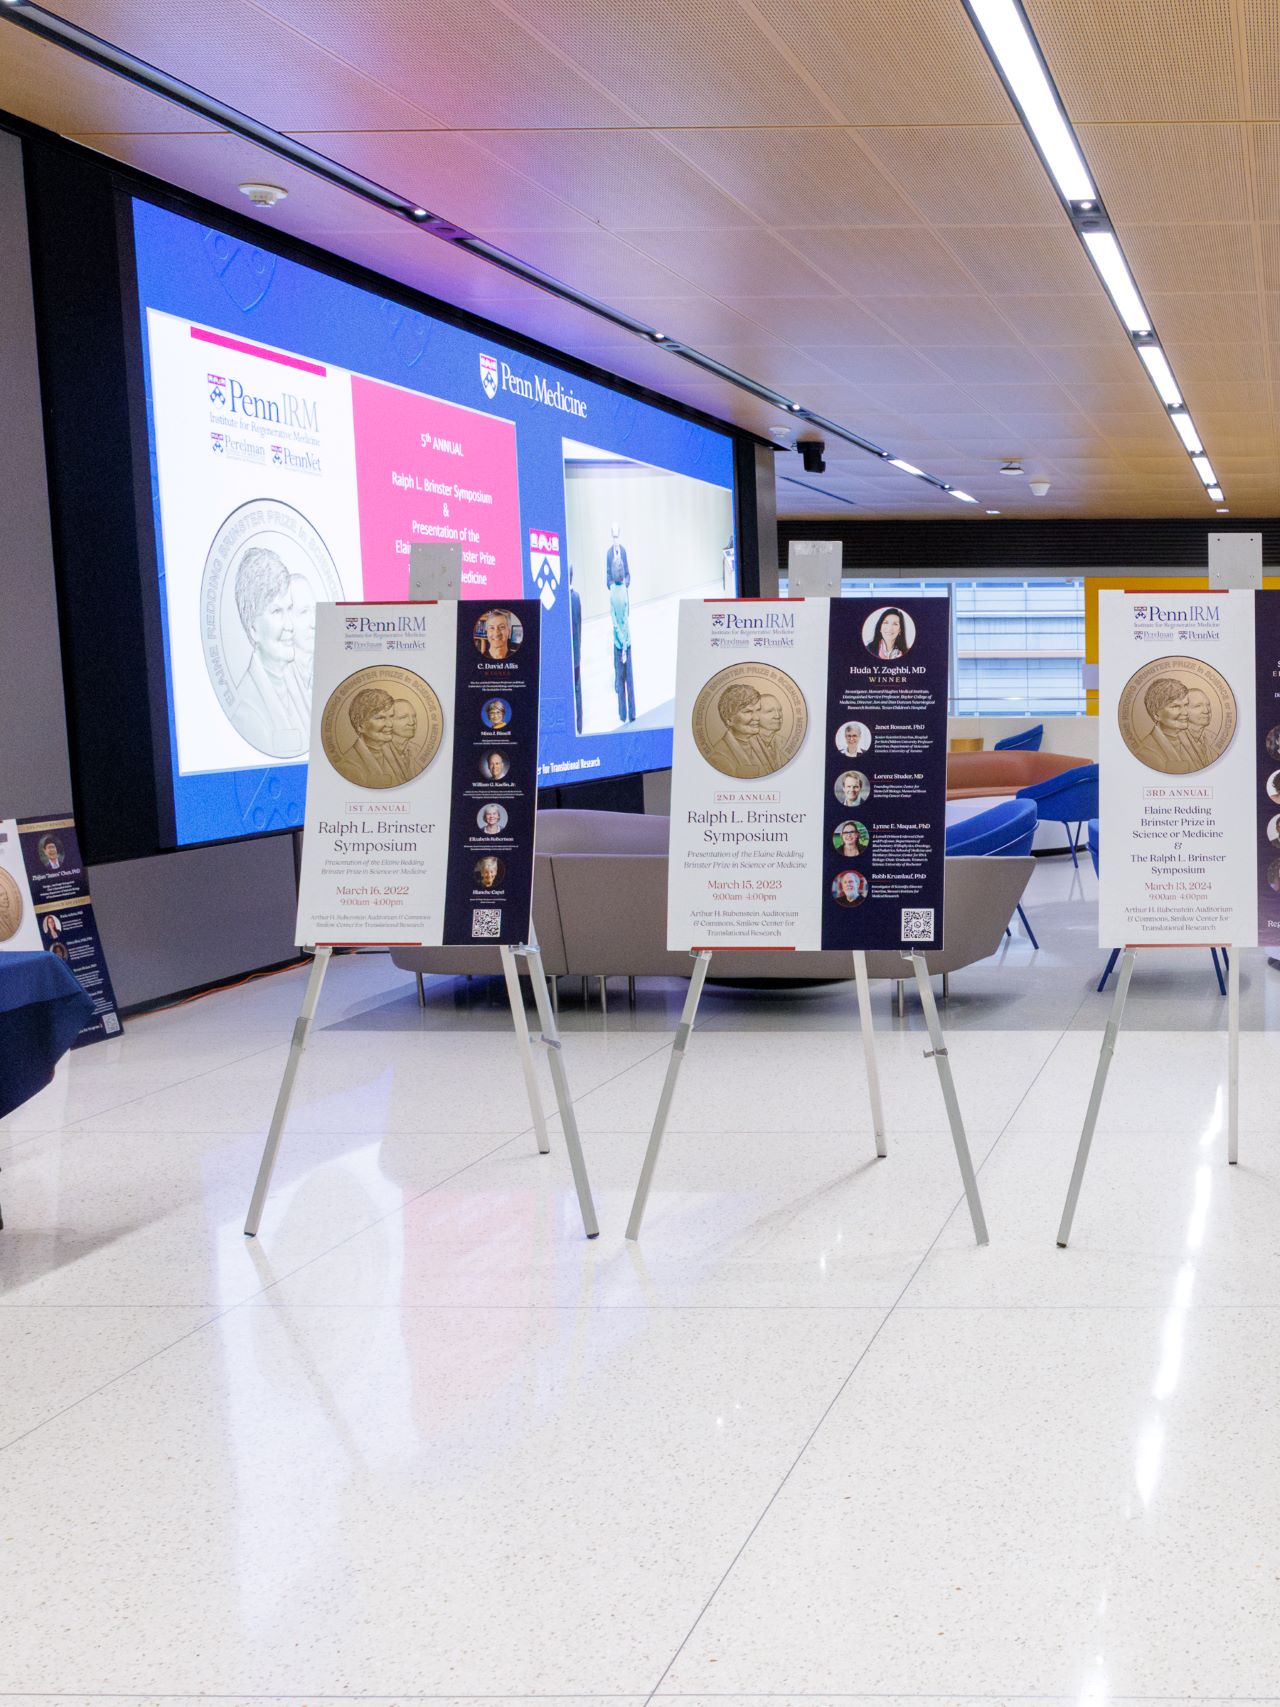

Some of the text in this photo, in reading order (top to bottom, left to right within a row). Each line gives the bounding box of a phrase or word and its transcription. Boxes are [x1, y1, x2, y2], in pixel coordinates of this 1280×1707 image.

[501, 362, 587, 418] Penn Medicine
[421, 433, 463, 456] 5th ANNUAL
[392, 472, 492, 505] Ralph L. Brinster Symposium
[443, 503, 449, 517] &
[412, 520, 479, 543] Presentation of the
[396, 540, 411, 554] Elai
[480, 552, 495, 565] Prize
[461, 572, 487, 585] edicine
[882, 666, 910, 675] Zoghbi,
[551, 760, 580, 772] Translational
[581, 757, 600, 769] Research
[1145, 806, 1211, 815] Elaine Redding
[688, 811, 806, 826] Ralph L. Brinster
[318, 821, 435, 836] Ralph L. Brinster
[1133, 830, 1168, 838] Science
[1182, 830, 1223, 838] Medicine
[704, 829, 788, 845] Symposium
[334, 840, 416, 854] Symposium
[1150, 854, 1176, 863] Ralph
[1188, 854, 1226, 862] Brinster
[1152, 866, 1205, 875] Symposium
[337, 886, 367, 894] March
[708, 880, 739, 889] March
[757, 880, 782, 889] 2023
